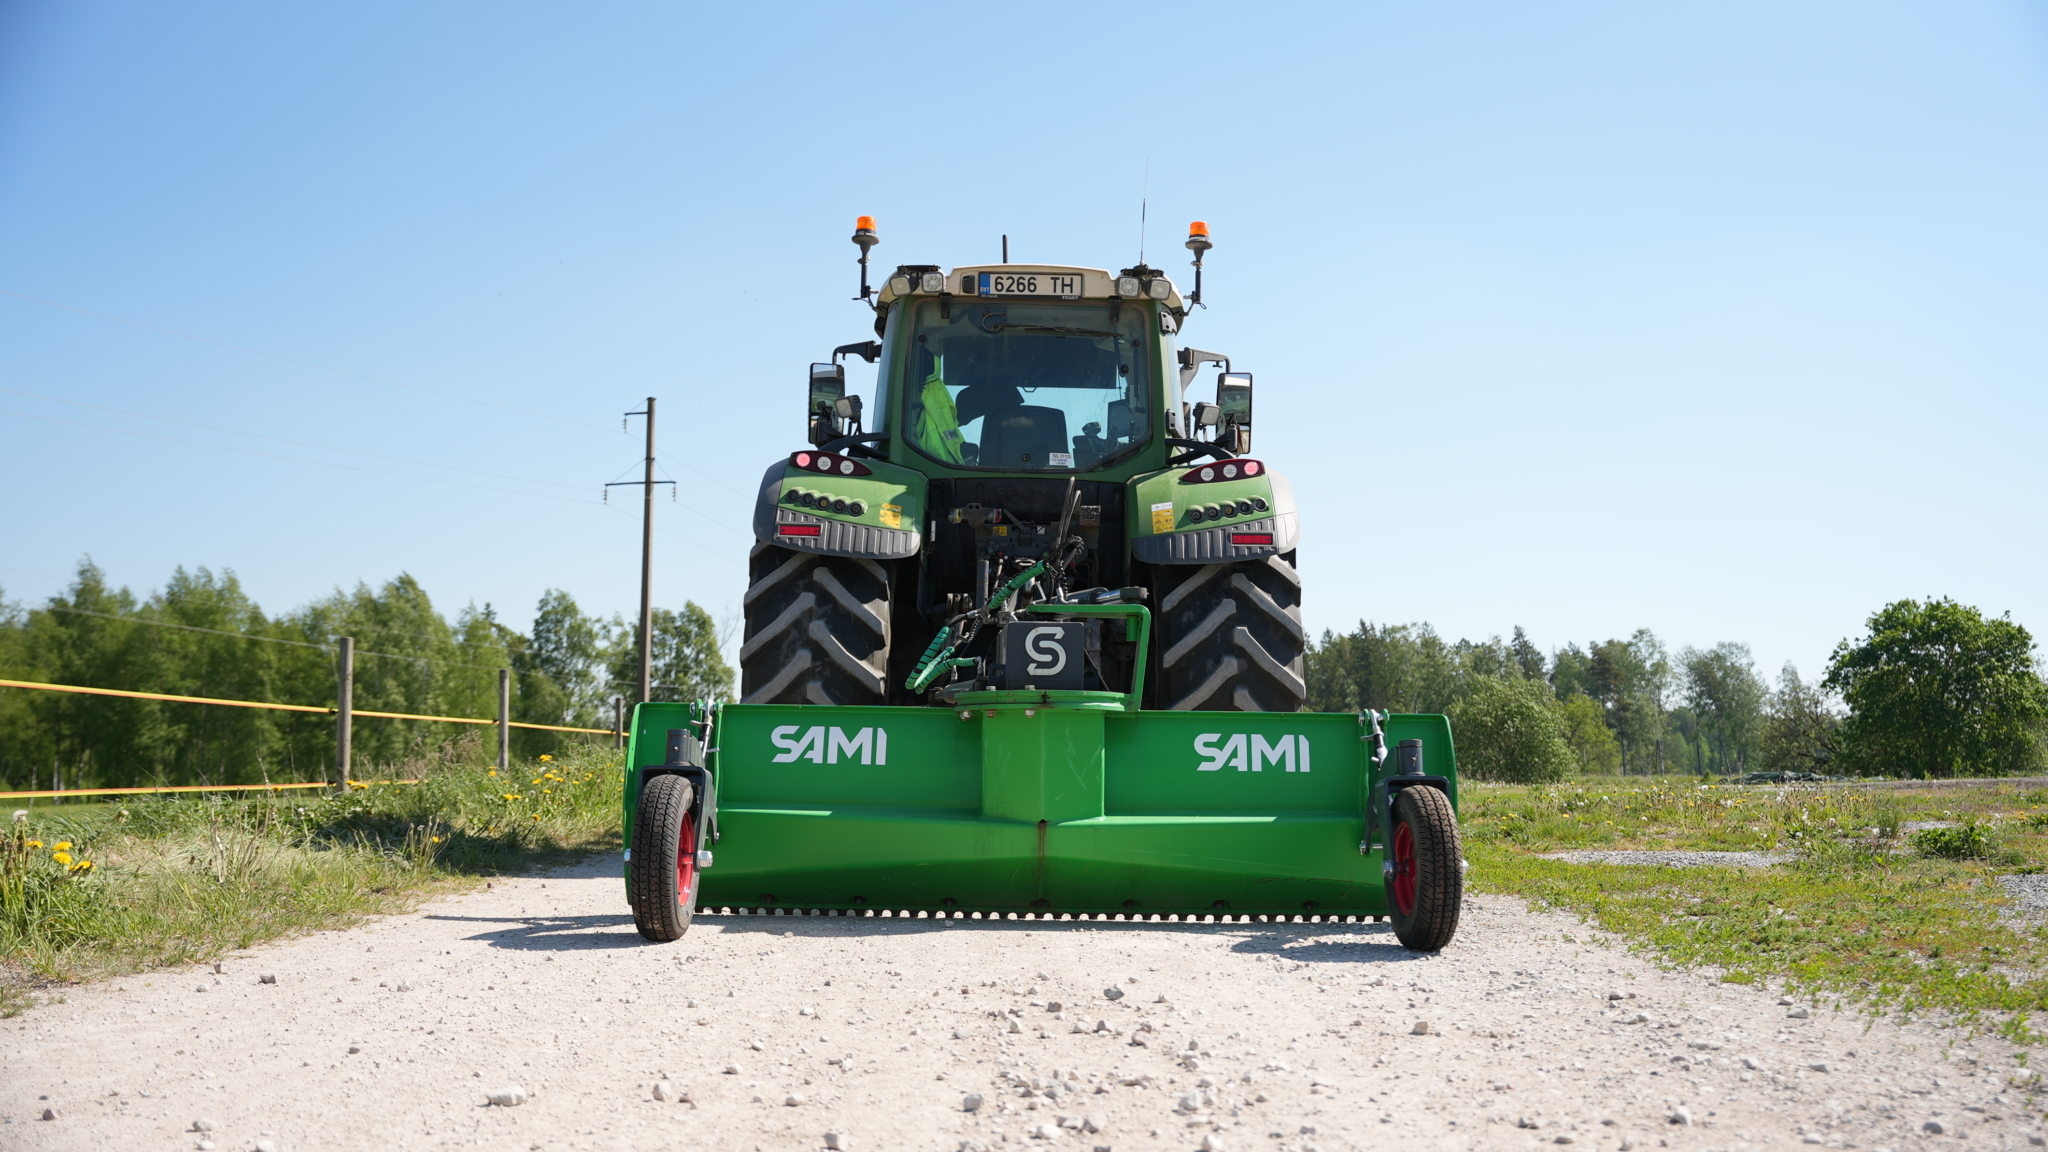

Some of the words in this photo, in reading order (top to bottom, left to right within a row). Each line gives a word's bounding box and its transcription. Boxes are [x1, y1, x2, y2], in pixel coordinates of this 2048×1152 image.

[994, 276, 1037, 293] 6266
[1050, 277, 1074, 294] TH
[770, 725, 888, 766] SAMI
[1193, 733, 1311, 773] SAMI
